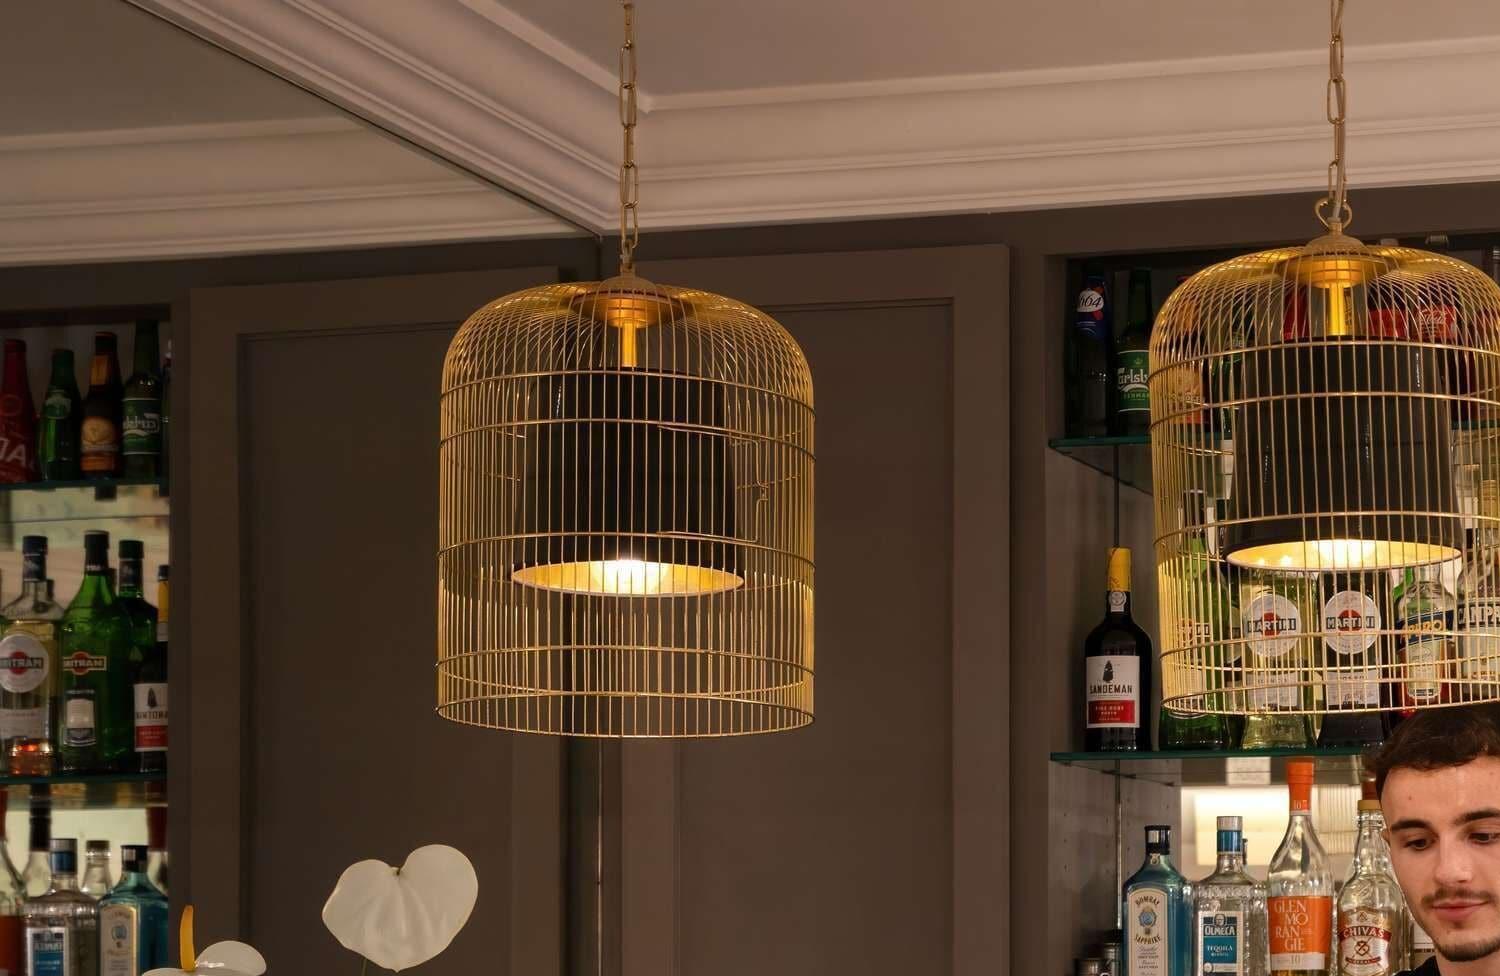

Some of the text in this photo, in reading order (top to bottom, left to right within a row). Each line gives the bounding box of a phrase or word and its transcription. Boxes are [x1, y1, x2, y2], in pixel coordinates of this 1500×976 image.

[1089, 684, 1133, 695] SANDEMAN
[1273, 899, 1307, 913] GLEN
[1284, 912, 1309, 926] MO
[1204, 925, 1236, 936] OLMECA
[1275, 926, 1301, 938] RAN
[1343, 926, 1385, 938] CHIVAS
